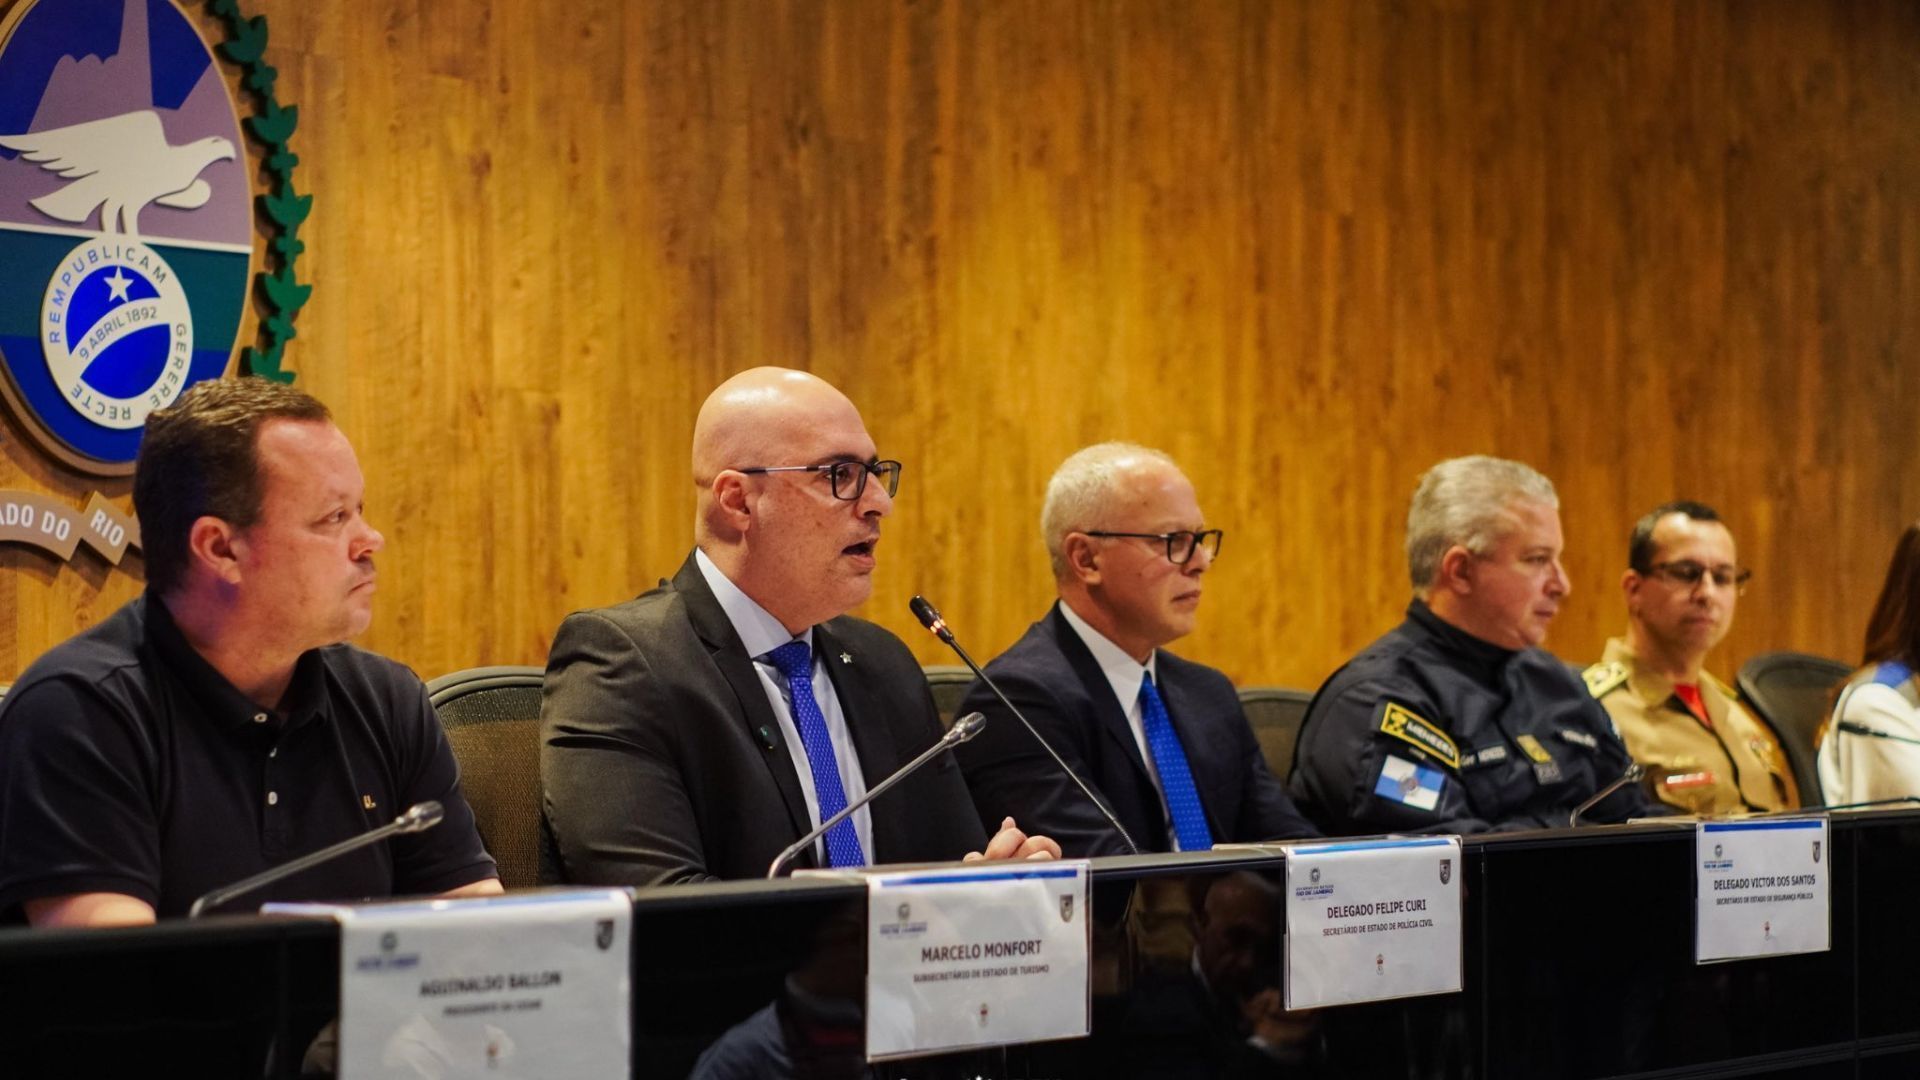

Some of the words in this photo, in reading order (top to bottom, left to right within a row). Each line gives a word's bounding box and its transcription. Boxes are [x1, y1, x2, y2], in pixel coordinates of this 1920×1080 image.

[49, 245, 167, 344] REMPUBLICAM
[79, 348, 89, 359] 9
[89, 317, 125, 347] ABRIL
[127, 306, 158, 323] 1892
[152, 323, 187, 408] GERERE
[71, 384, 131, 420] RECTE
[41, 511, 70, 541] DO
[90, 508, 124, 547] RIO
[1714, 878, 1750, 890] DELEGADO
[1751, 876, 1775, 888] VICTOR
[1776, 876, 1790, 887] DOS
[1791, 874, 1816, 886] SANTOS
[1327, 903, 1374, 918] DELEGADO
[1376, 901, 1404, 915] FELIPE
[1406, 899, 1426, 912] CURI
[1368, 924, 1388, 932] ESTADO
[1389, 922, 1396, 930] DE
[1398, 919, 1418, 930] POLÍCIA
[1419, 919, 1433, 928] CIVIL
[922, 944, 980, 962] MARCELO
[984, 940, 1042, 958] MONFORT
[972, 969, 980, 979] DE
[982, 966, 1008, 978] ESTADO
[1010, 966, 1018, 976] DE
[1020, 964, 1049, 974] TURISMO
